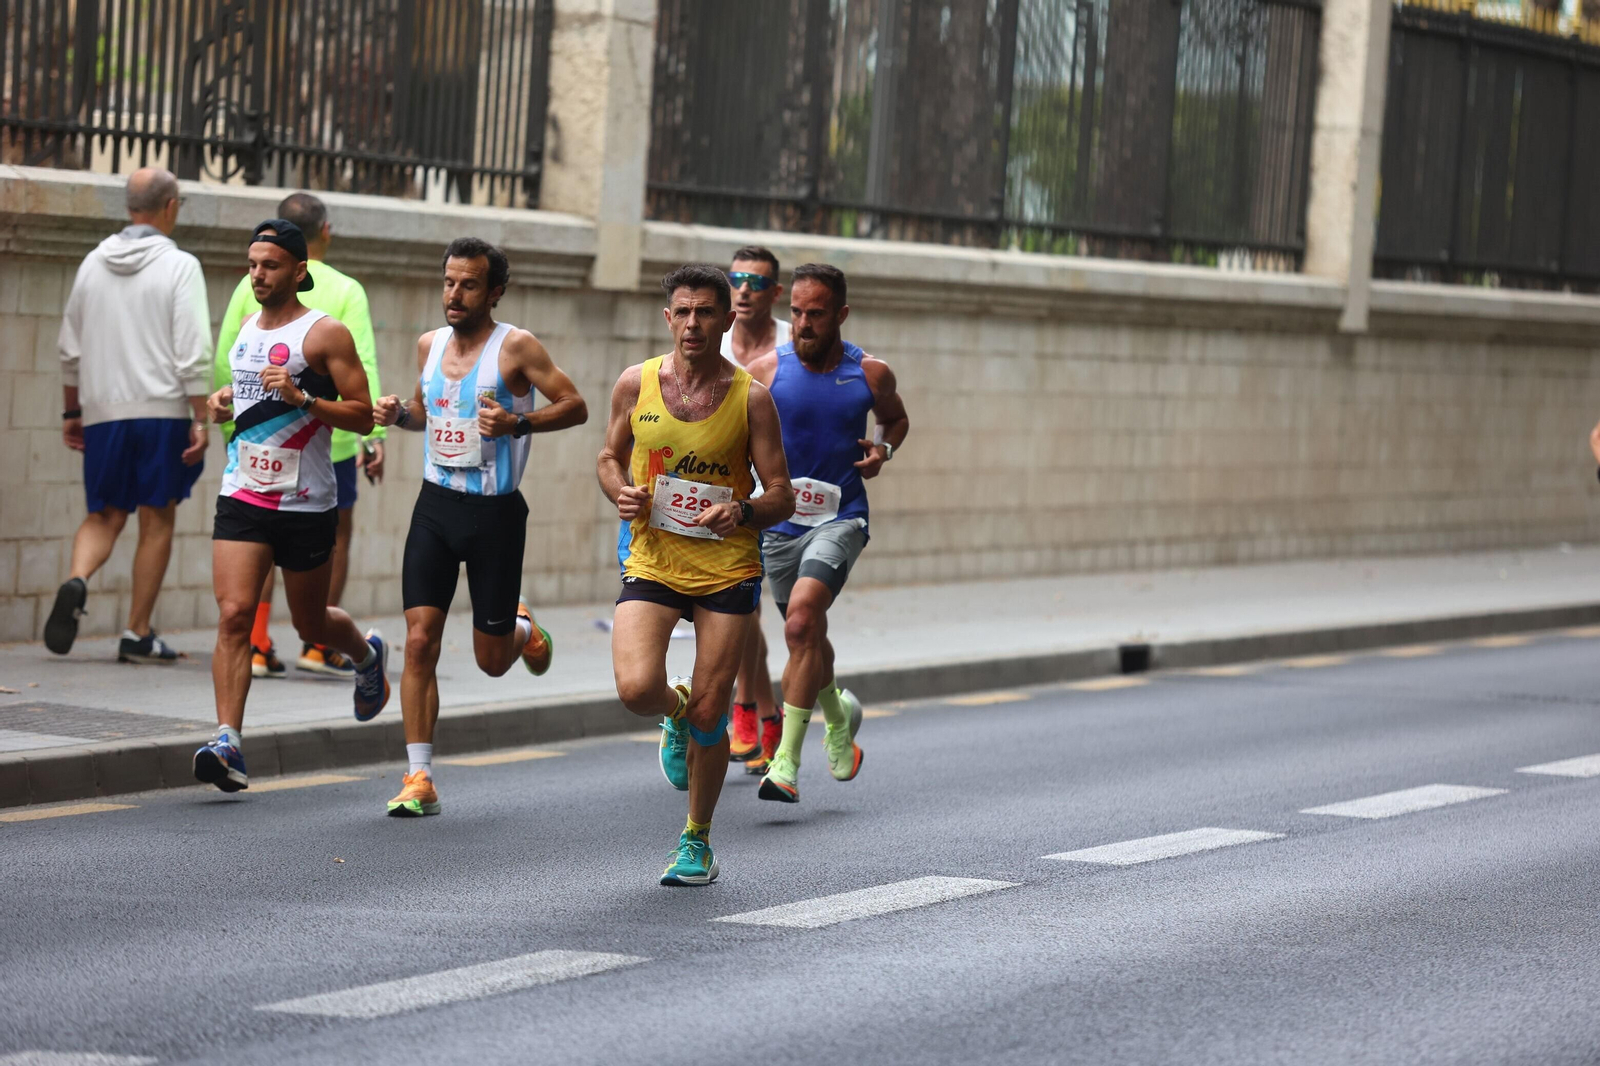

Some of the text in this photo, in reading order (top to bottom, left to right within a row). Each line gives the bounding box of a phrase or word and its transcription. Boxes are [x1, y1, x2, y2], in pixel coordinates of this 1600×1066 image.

[434, 429, 465, 444] 723
[250, 456, 283, 472] 730
[674, 450, 731, 477] Álora
[670, 493, 713, 513] 229
